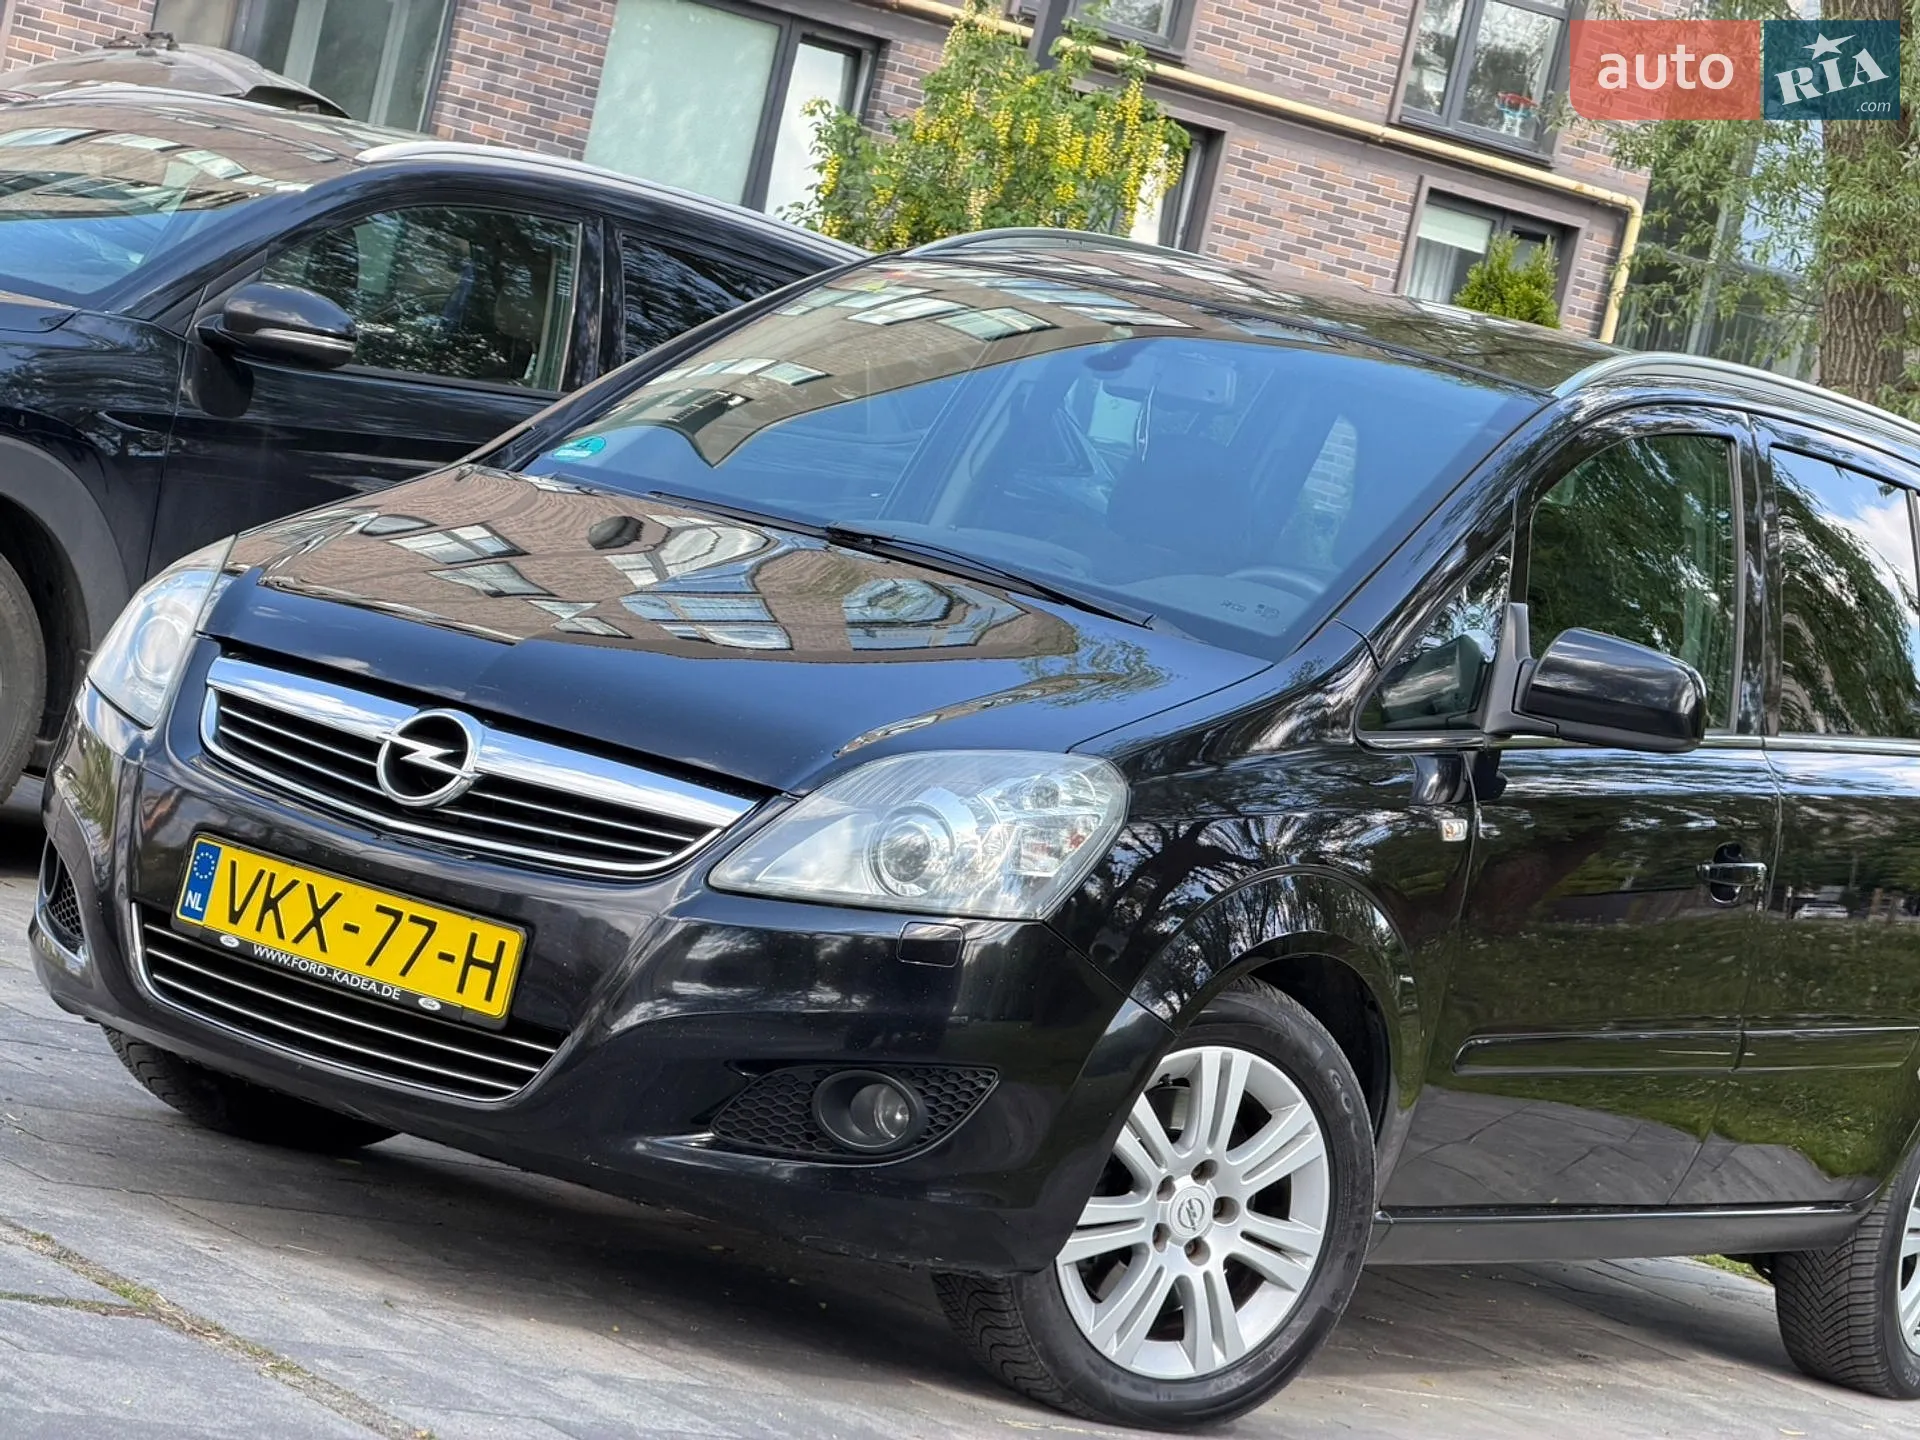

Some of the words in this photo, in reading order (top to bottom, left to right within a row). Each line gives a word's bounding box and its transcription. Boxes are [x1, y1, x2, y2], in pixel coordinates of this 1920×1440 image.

[184, 889, 203, 912] NL
[229, 860, 505, 1002] VKX-77-H
[252, 944, 401, 1001] WWW.FORD-KADEA.DE
